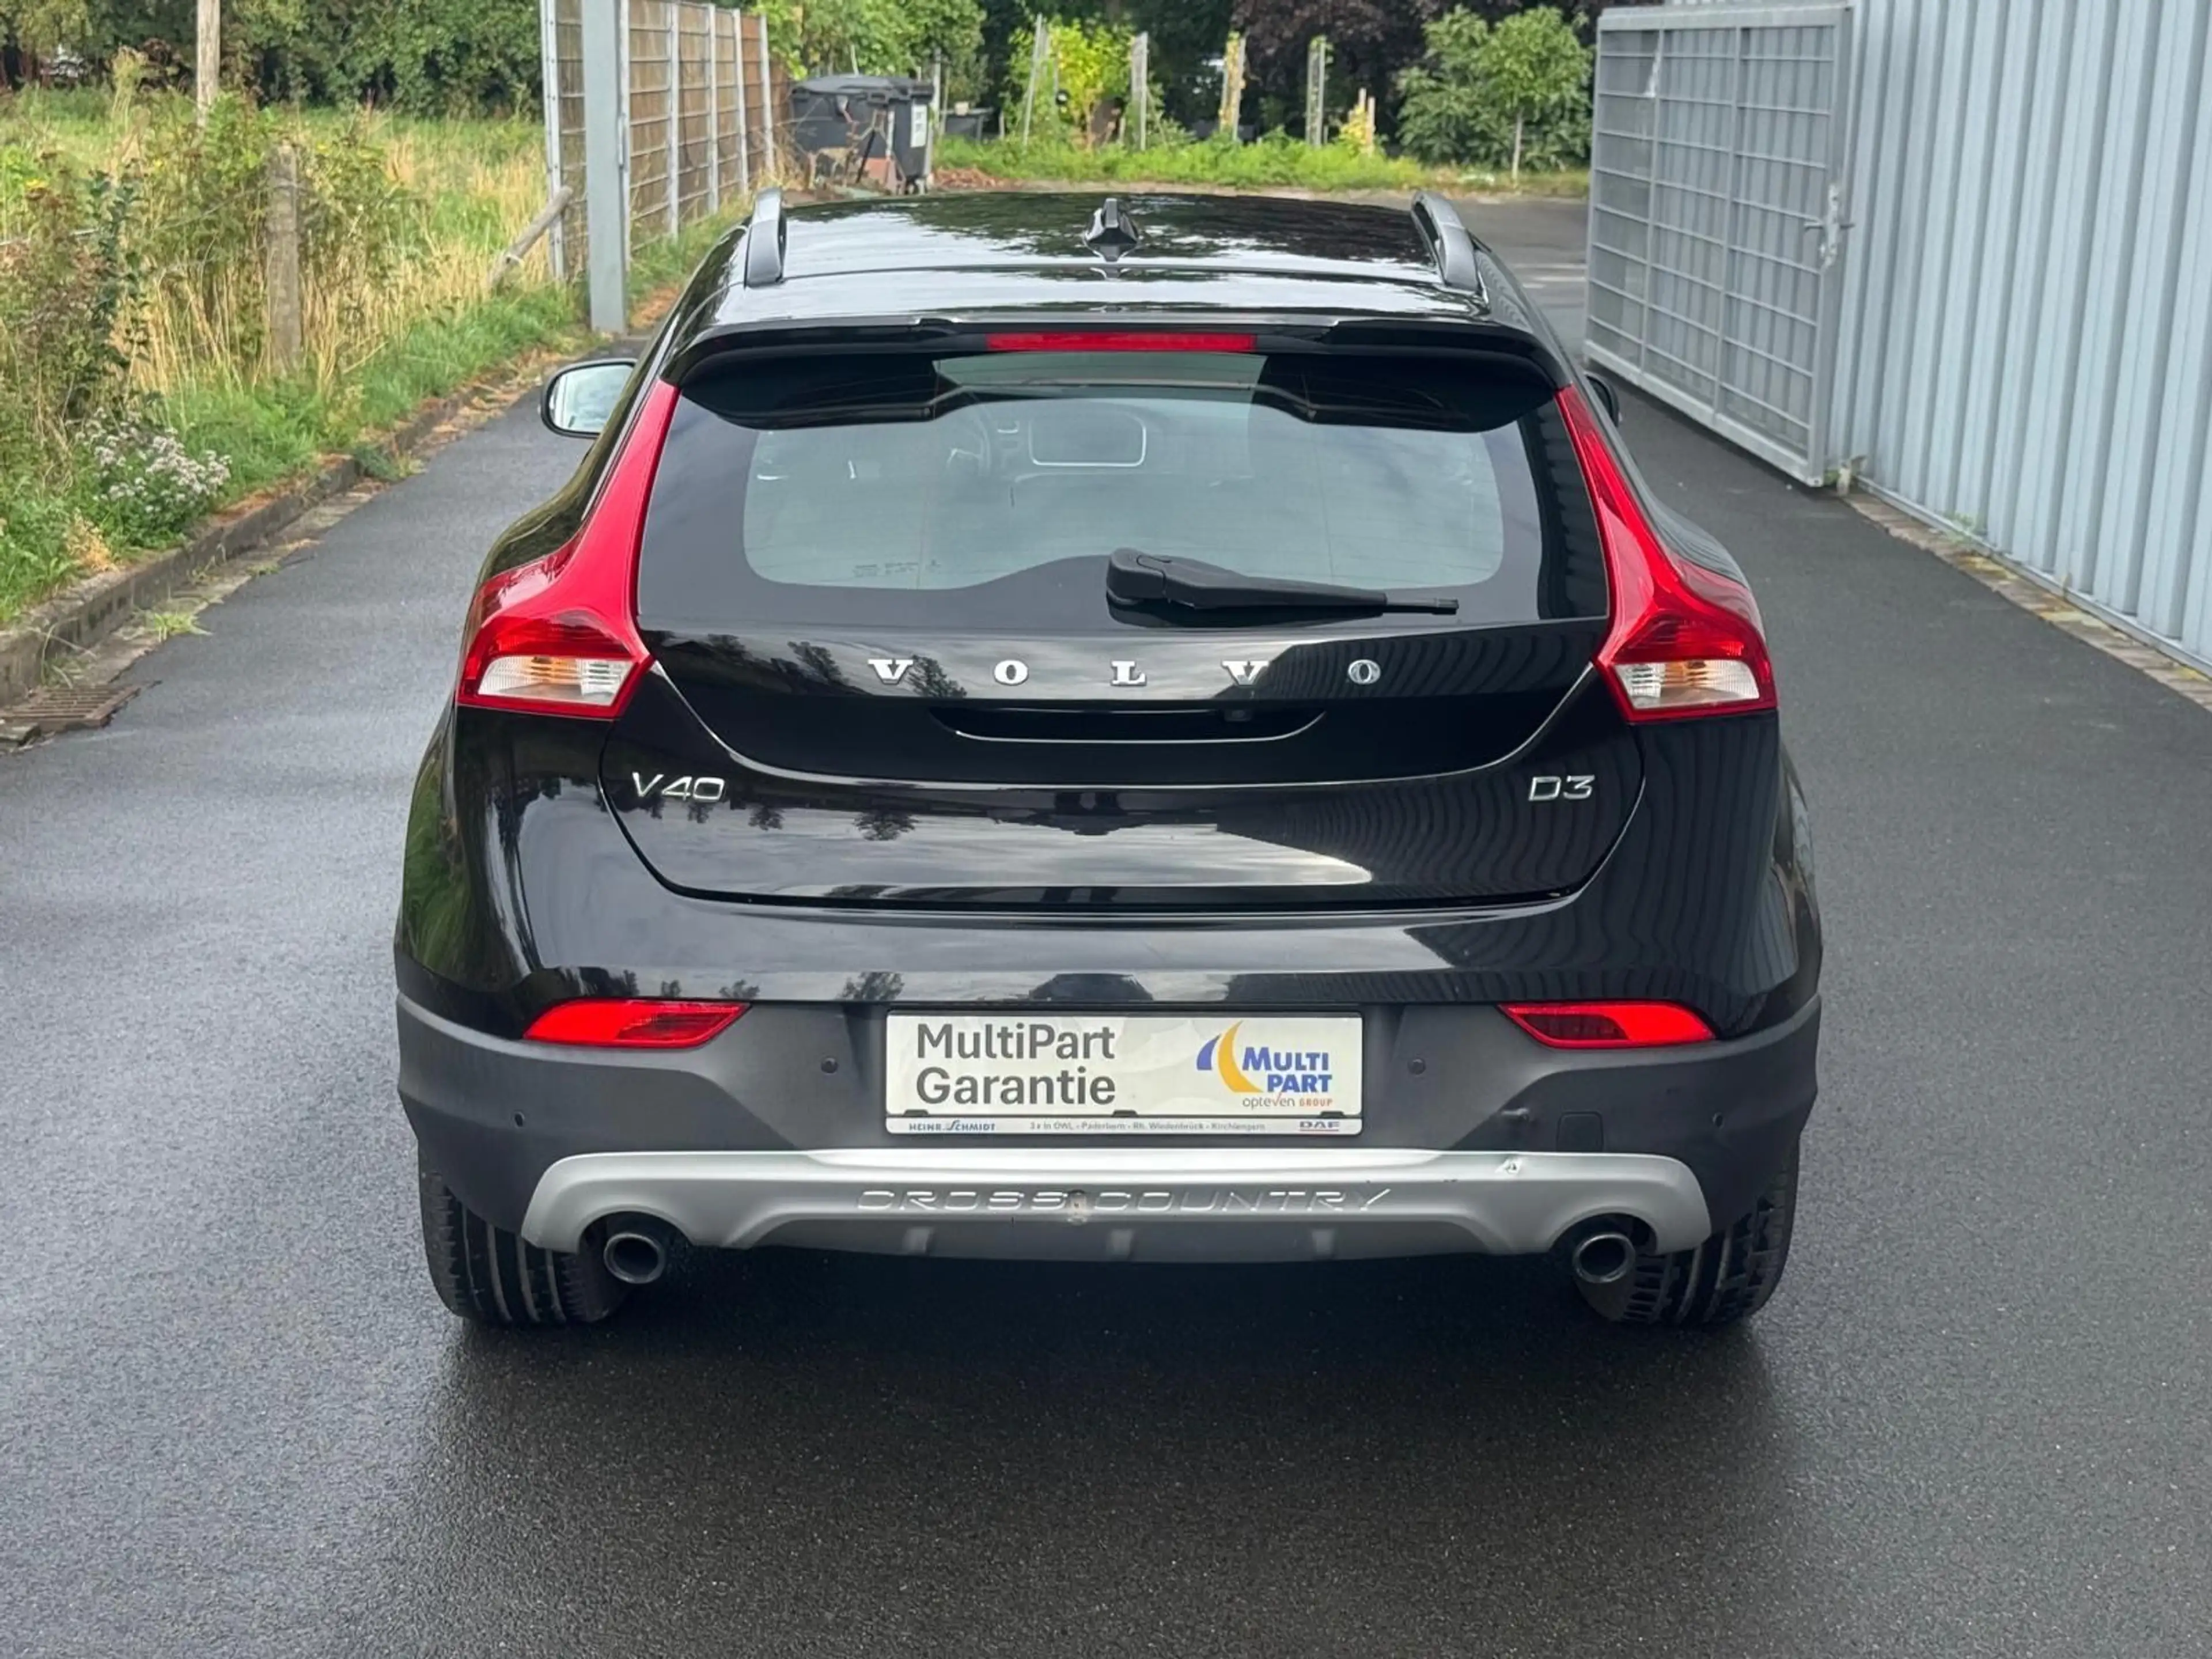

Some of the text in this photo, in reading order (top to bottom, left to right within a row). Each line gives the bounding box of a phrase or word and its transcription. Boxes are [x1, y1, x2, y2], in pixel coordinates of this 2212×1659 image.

[868, 658, 1381, 687] VOLVO
[632, 771, 725, 802] V40
[1528, 774, 1596, 801] D3
[917, 1022, 1115, 1059] MultiPart
[1242, 1046, 1330, 1071] MULTI
[916, 1066, 1116, 1105] Garantie
[1267, 1074, 1333, 1093] PART
[1242, 1093, 1334, 1109] opteven GROUP
[946, 1119, 996, 1131] SCHMIDT
[1299, 1120, 1339, 1129] DAF
[857, 1188, 1391, 1211] CROSS COUNTRY
